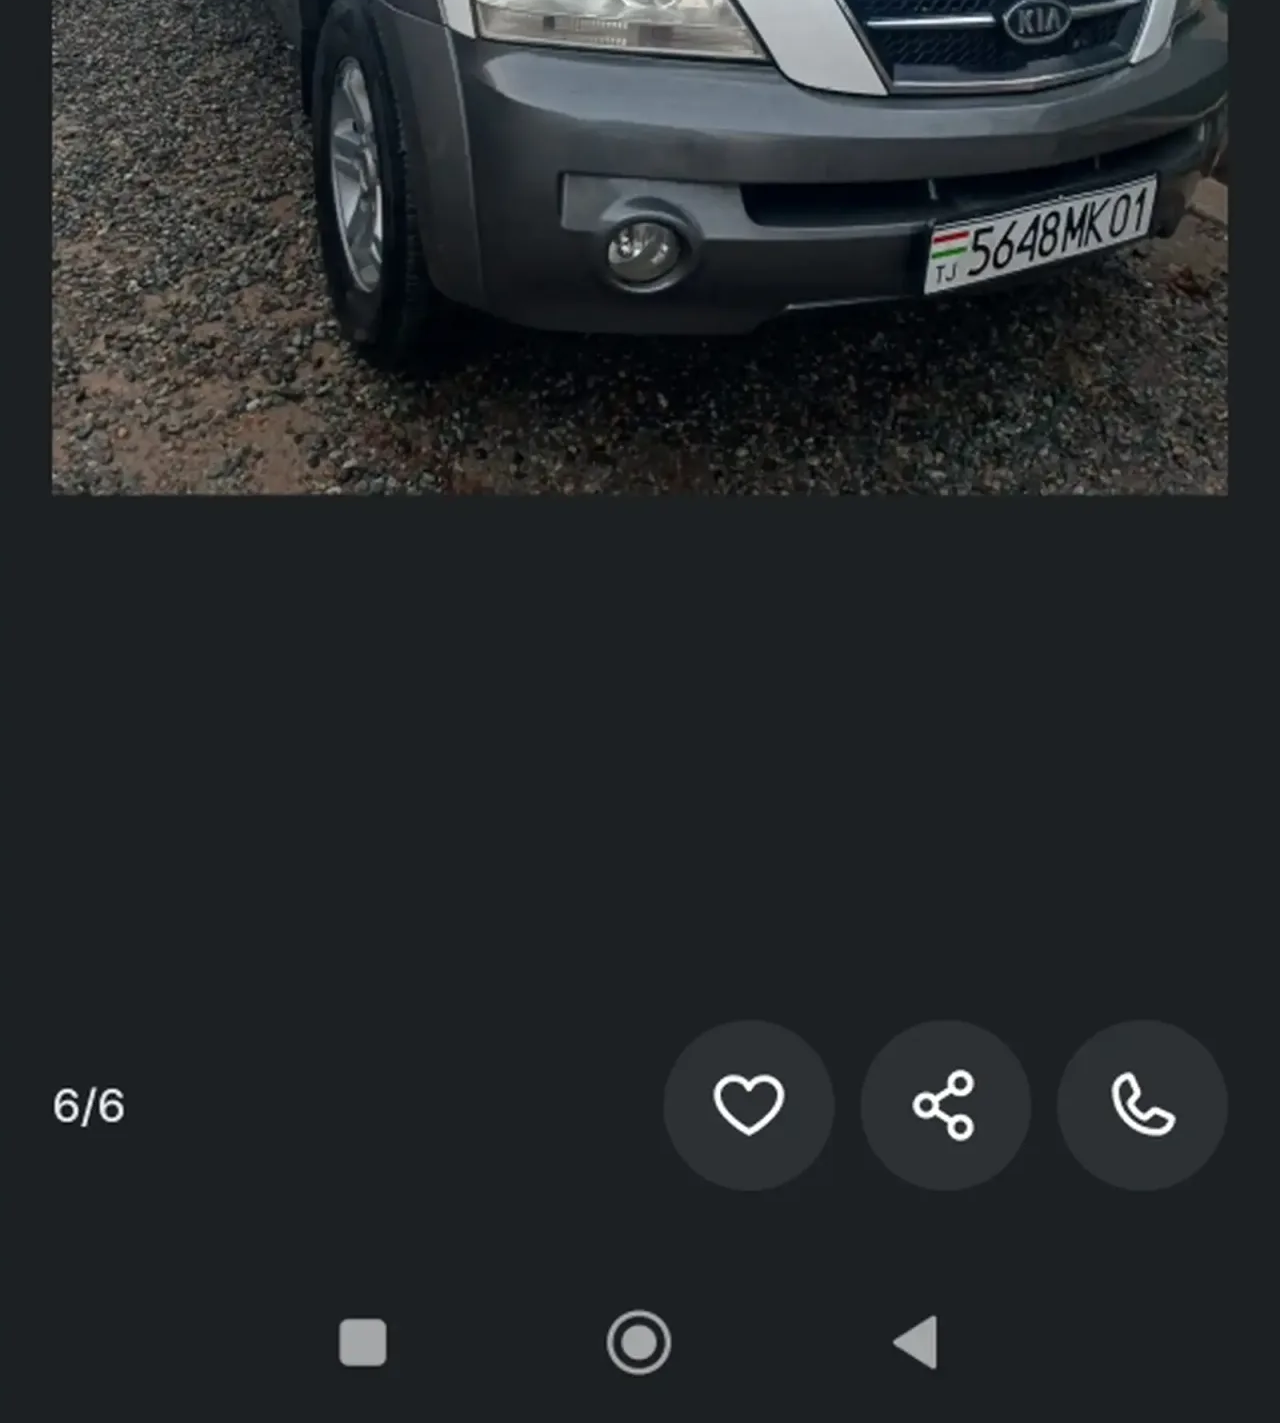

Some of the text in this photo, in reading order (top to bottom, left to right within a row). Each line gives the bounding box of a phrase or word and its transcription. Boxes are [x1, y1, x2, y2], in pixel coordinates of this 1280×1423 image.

[1018, 4, 1061, 36] KIA
[935, 261, 958, 285] TJ
[53, 1086, 125, 1128] 6/6
